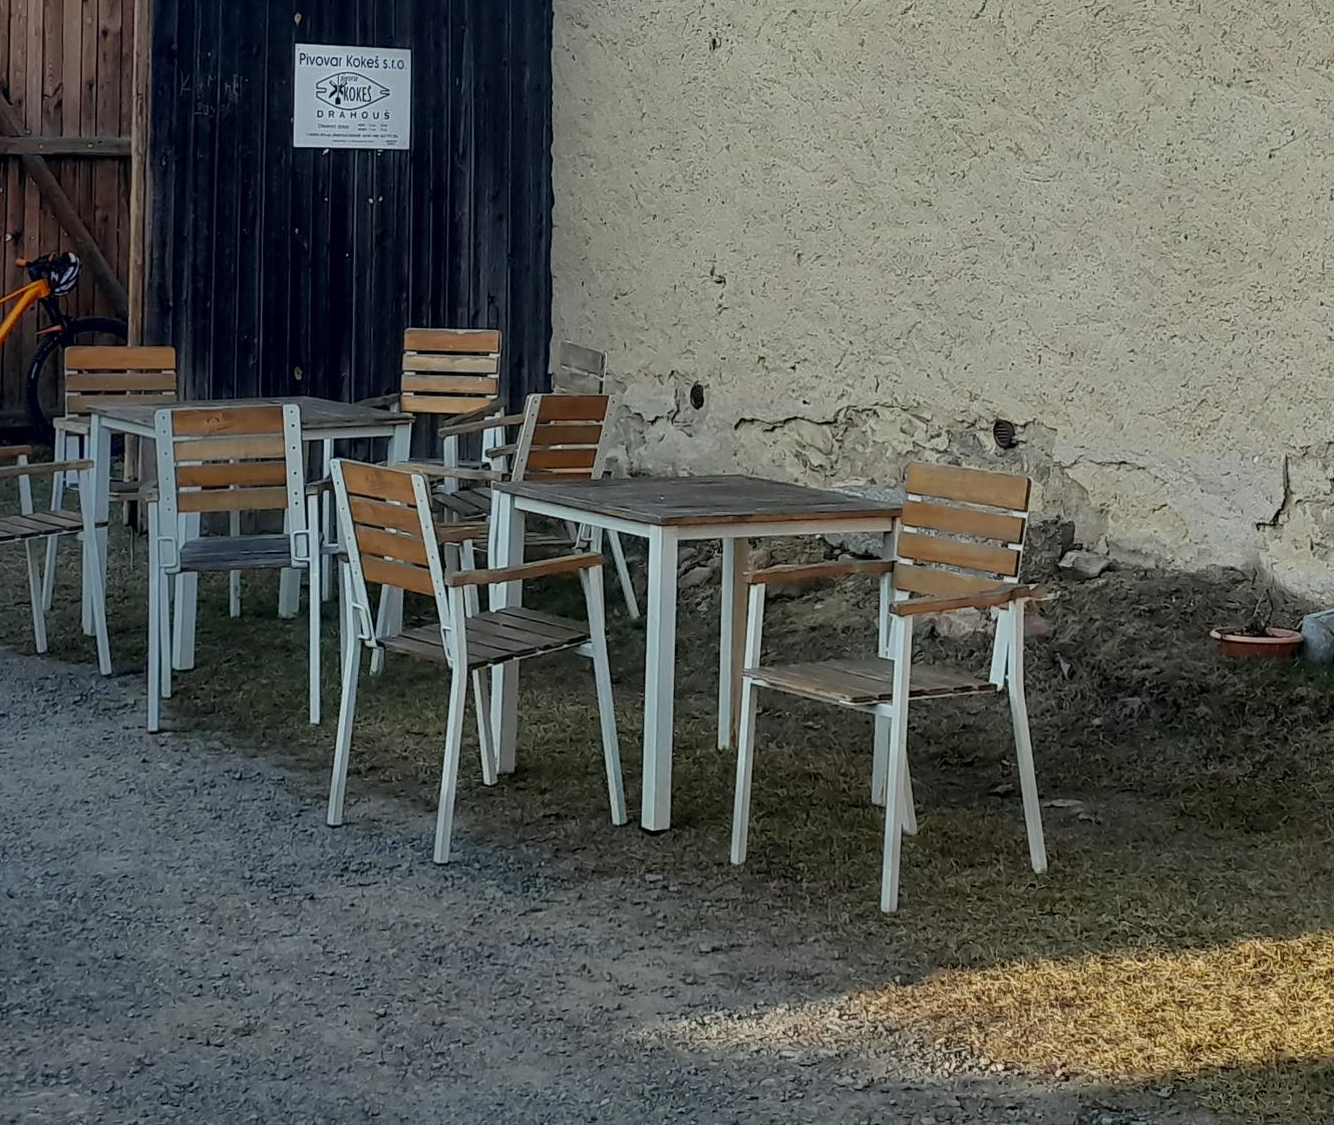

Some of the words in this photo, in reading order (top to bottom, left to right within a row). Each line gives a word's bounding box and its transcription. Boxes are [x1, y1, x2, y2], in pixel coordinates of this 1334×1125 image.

[299, 53, 342, 67] Pivovar
[346, 55, 379, 69] Kokeš
[383, 59, 407, 70] s.r.o.
[343, 85, 372, 102] KOKEŠ
[317, 109, 390, 120] DRAHOUŠ
